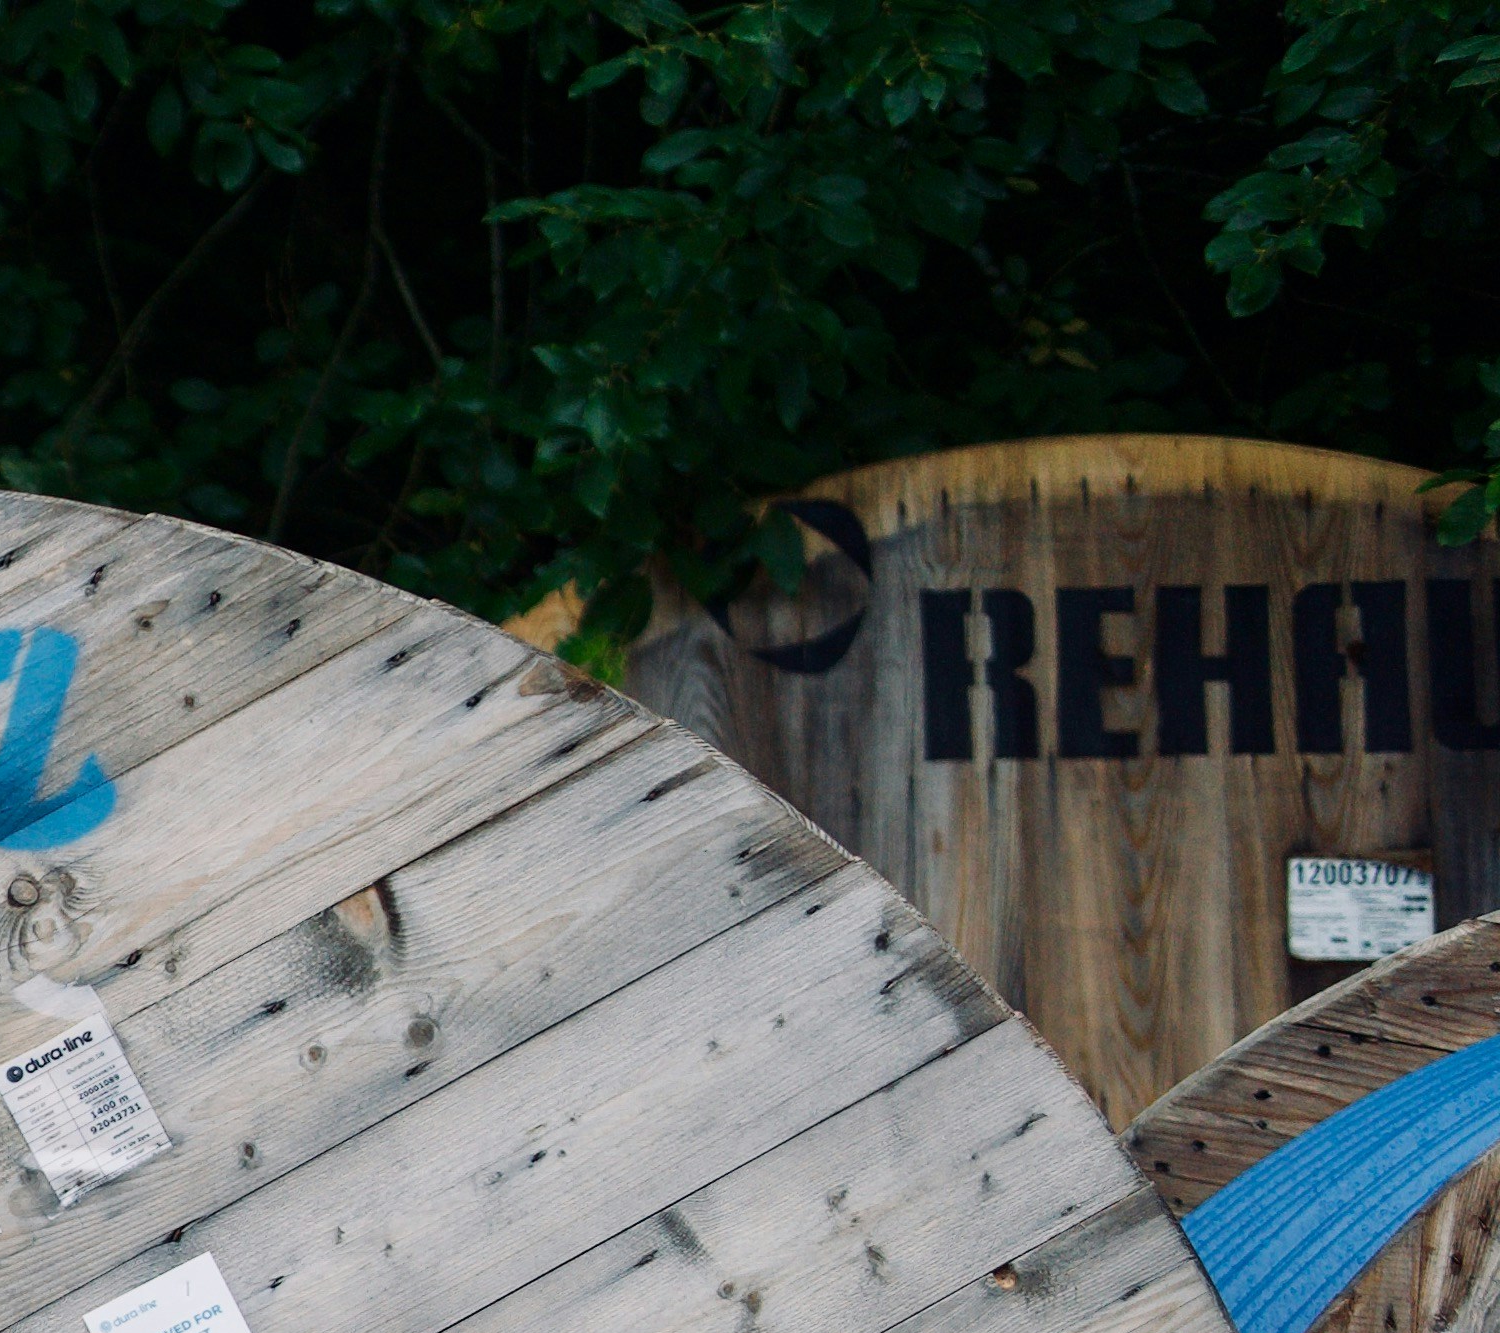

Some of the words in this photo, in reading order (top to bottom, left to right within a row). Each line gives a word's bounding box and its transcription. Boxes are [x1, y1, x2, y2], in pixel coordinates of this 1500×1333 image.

[90, 1101, 116, 1119] 1400
[118, 1094, 129, 1106] m
[90, 1103, 141, 1135] 92043731
[193, 1304, 223, 1325] FOR
